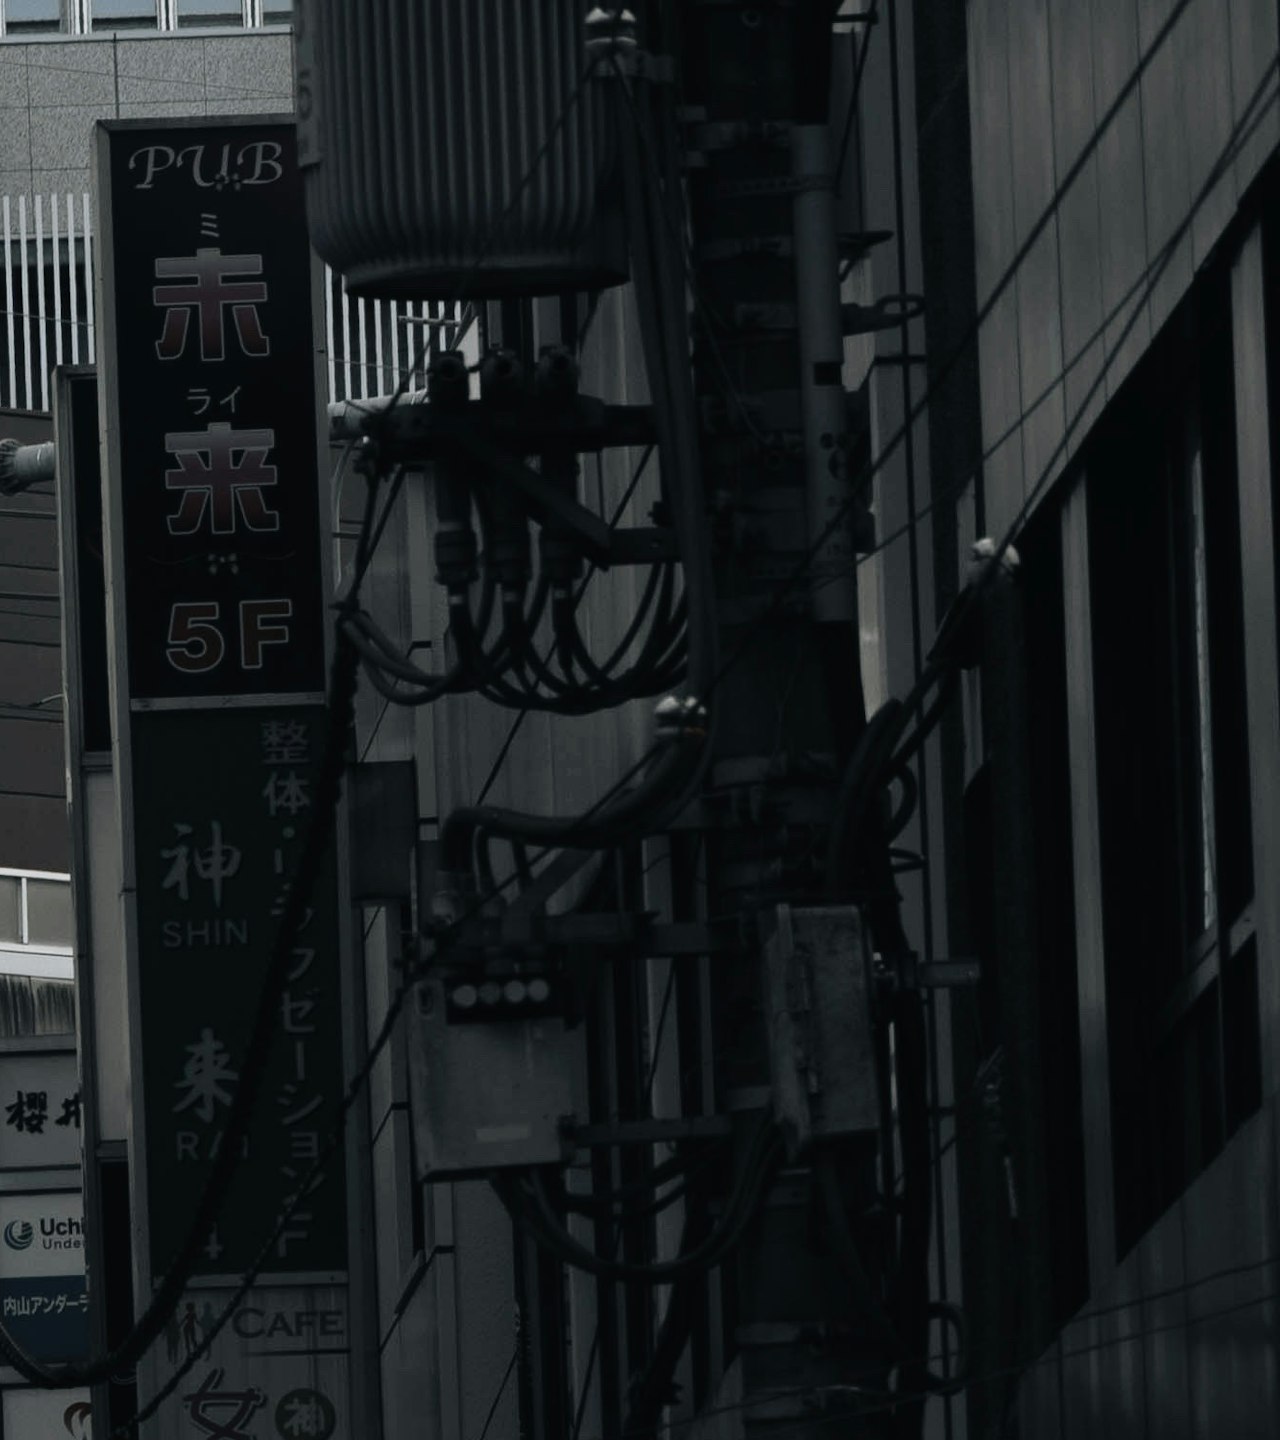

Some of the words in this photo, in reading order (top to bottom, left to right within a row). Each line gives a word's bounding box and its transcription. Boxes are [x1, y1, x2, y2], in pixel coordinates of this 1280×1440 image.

[128, 141, 285, 191] PUB
[165, 600, 292, 673] 5F
[163, 919, 249, 948] SHIN
